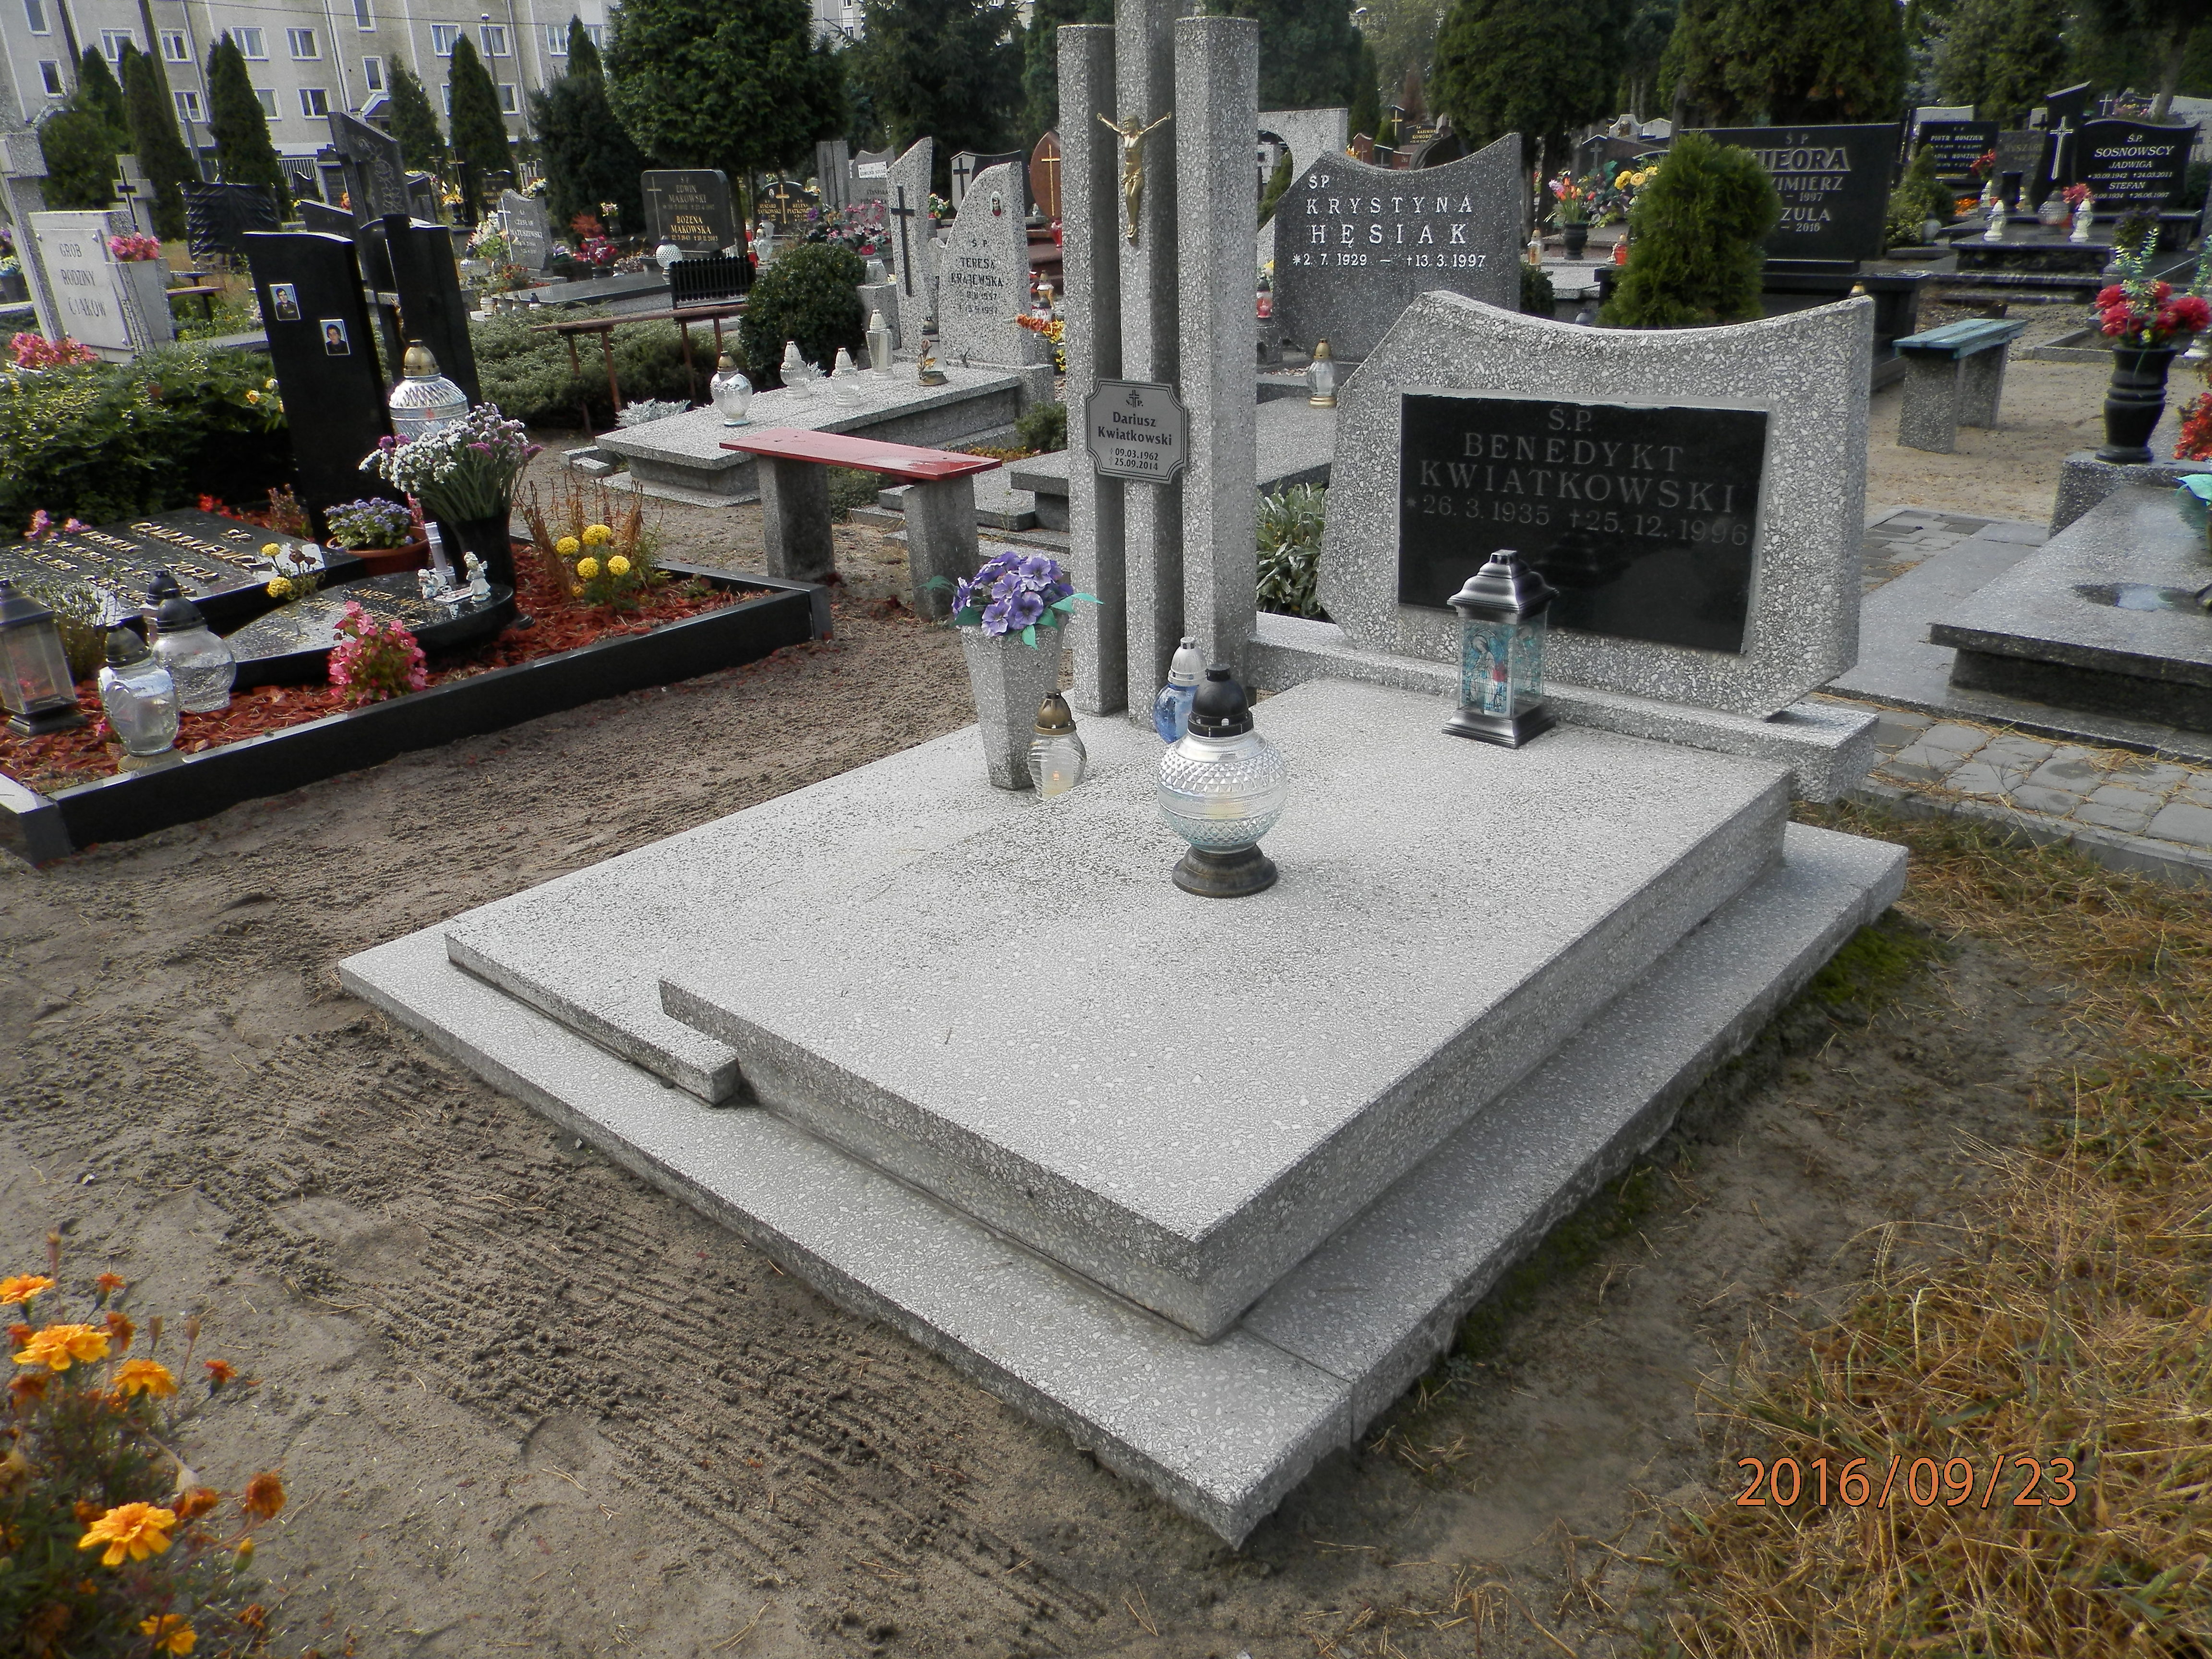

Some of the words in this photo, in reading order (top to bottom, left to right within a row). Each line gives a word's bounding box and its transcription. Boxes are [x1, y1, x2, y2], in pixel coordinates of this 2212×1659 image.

[2094, 145, 2175, 157] SOSNOWSCY
[1755, 146, 1851, 172] IEORA
[676, 185, 697, 193] EDWIN
[2109, 181, 2146, 190] STEFAN
[668, 194, 707, 203] MAKOWSKI
[1306, 194, 1472, 215] KRYSTYNA
[1780, 207, 1831, 221] ZULA
[670, 225, 711, 234] MAKOWSKA
[1310, 224, 1467, 249] HĘSIAK
[960, 257, 995, 270] TERESA
[1337, 253, 1368, 266] 1929
[1453, 254, 1486, 268] 1997
[60, 269, 96, 286] RODZINY
[951, 273, 1004, 288] KRAJEWSKA
[1113, 411, 1156, 427] Dariusz
[1098, 426, 1172, 445] Kwiatkowski
[1115, 448, 1159, 461] 09.03.1962
[1463, 433, 1683, 471] BENEDYKT
[1114, 457, 1158, 470] 25.09.2014
[1420, 460, 1734, 513] KWIATKOWSKI
[1491, 501, 1550, 526] 1935
[1679, 518, 1748, 546] 1996
[81, 530, 142, 554] HENRYK
[164, 561, 219, 580] ZOFIA
